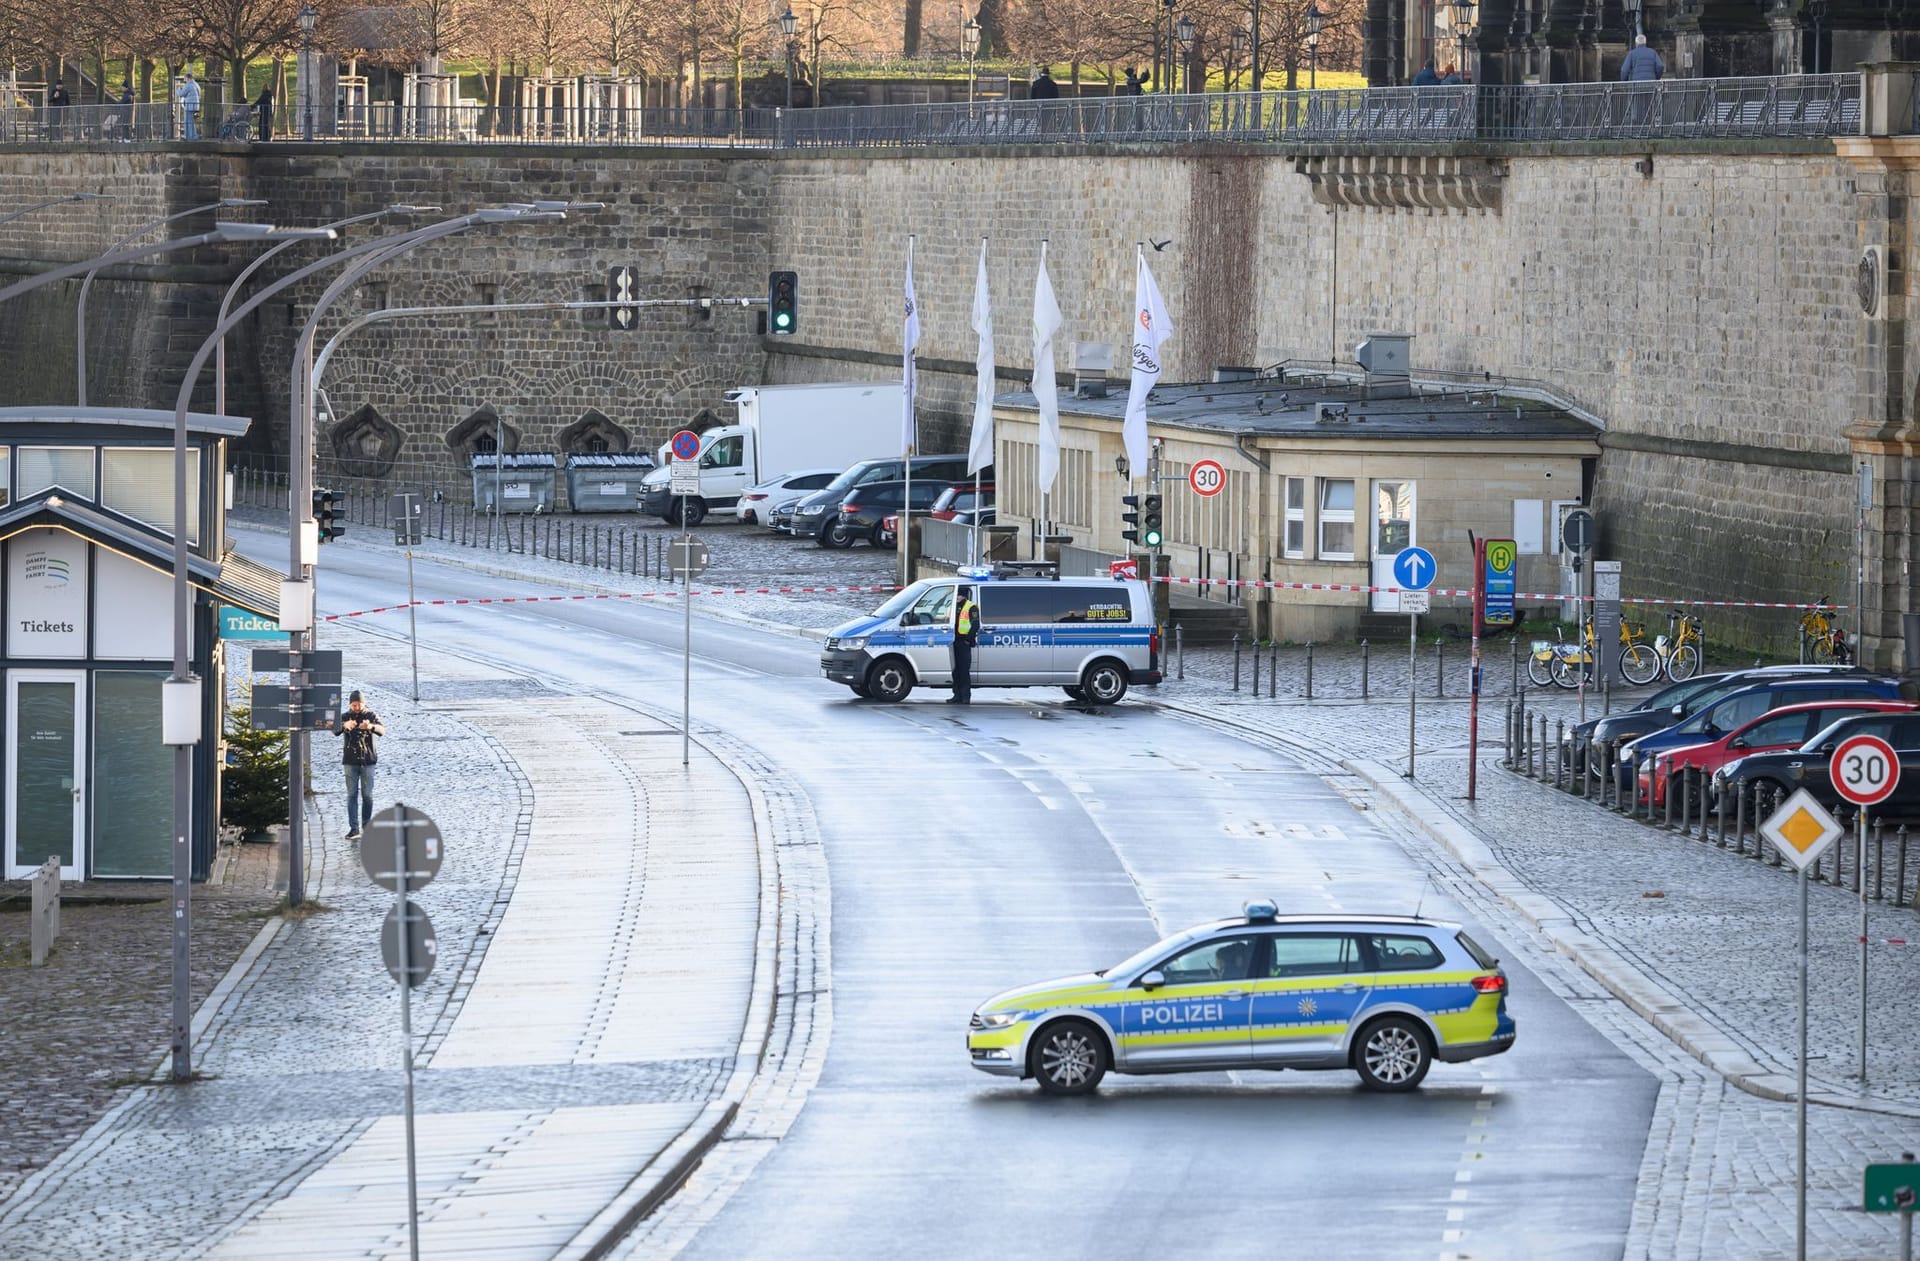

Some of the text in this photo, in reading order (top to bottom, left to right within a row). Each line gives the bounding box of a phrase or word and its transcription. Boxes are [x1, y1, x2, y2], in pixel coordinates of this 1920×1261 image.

[1197, 470, 1218, 486] 30
[1496, 552, 1505, 566] H
[1087, 609, 1126, 618] GUTE JOBS!
[20, 620, 74, 633] Tickets
[993, 635, 1042, 646] POLIZEI
[1846, 755, 1884, 785] 30
[1141, 1003, 1223, 1025] POLIZEI
